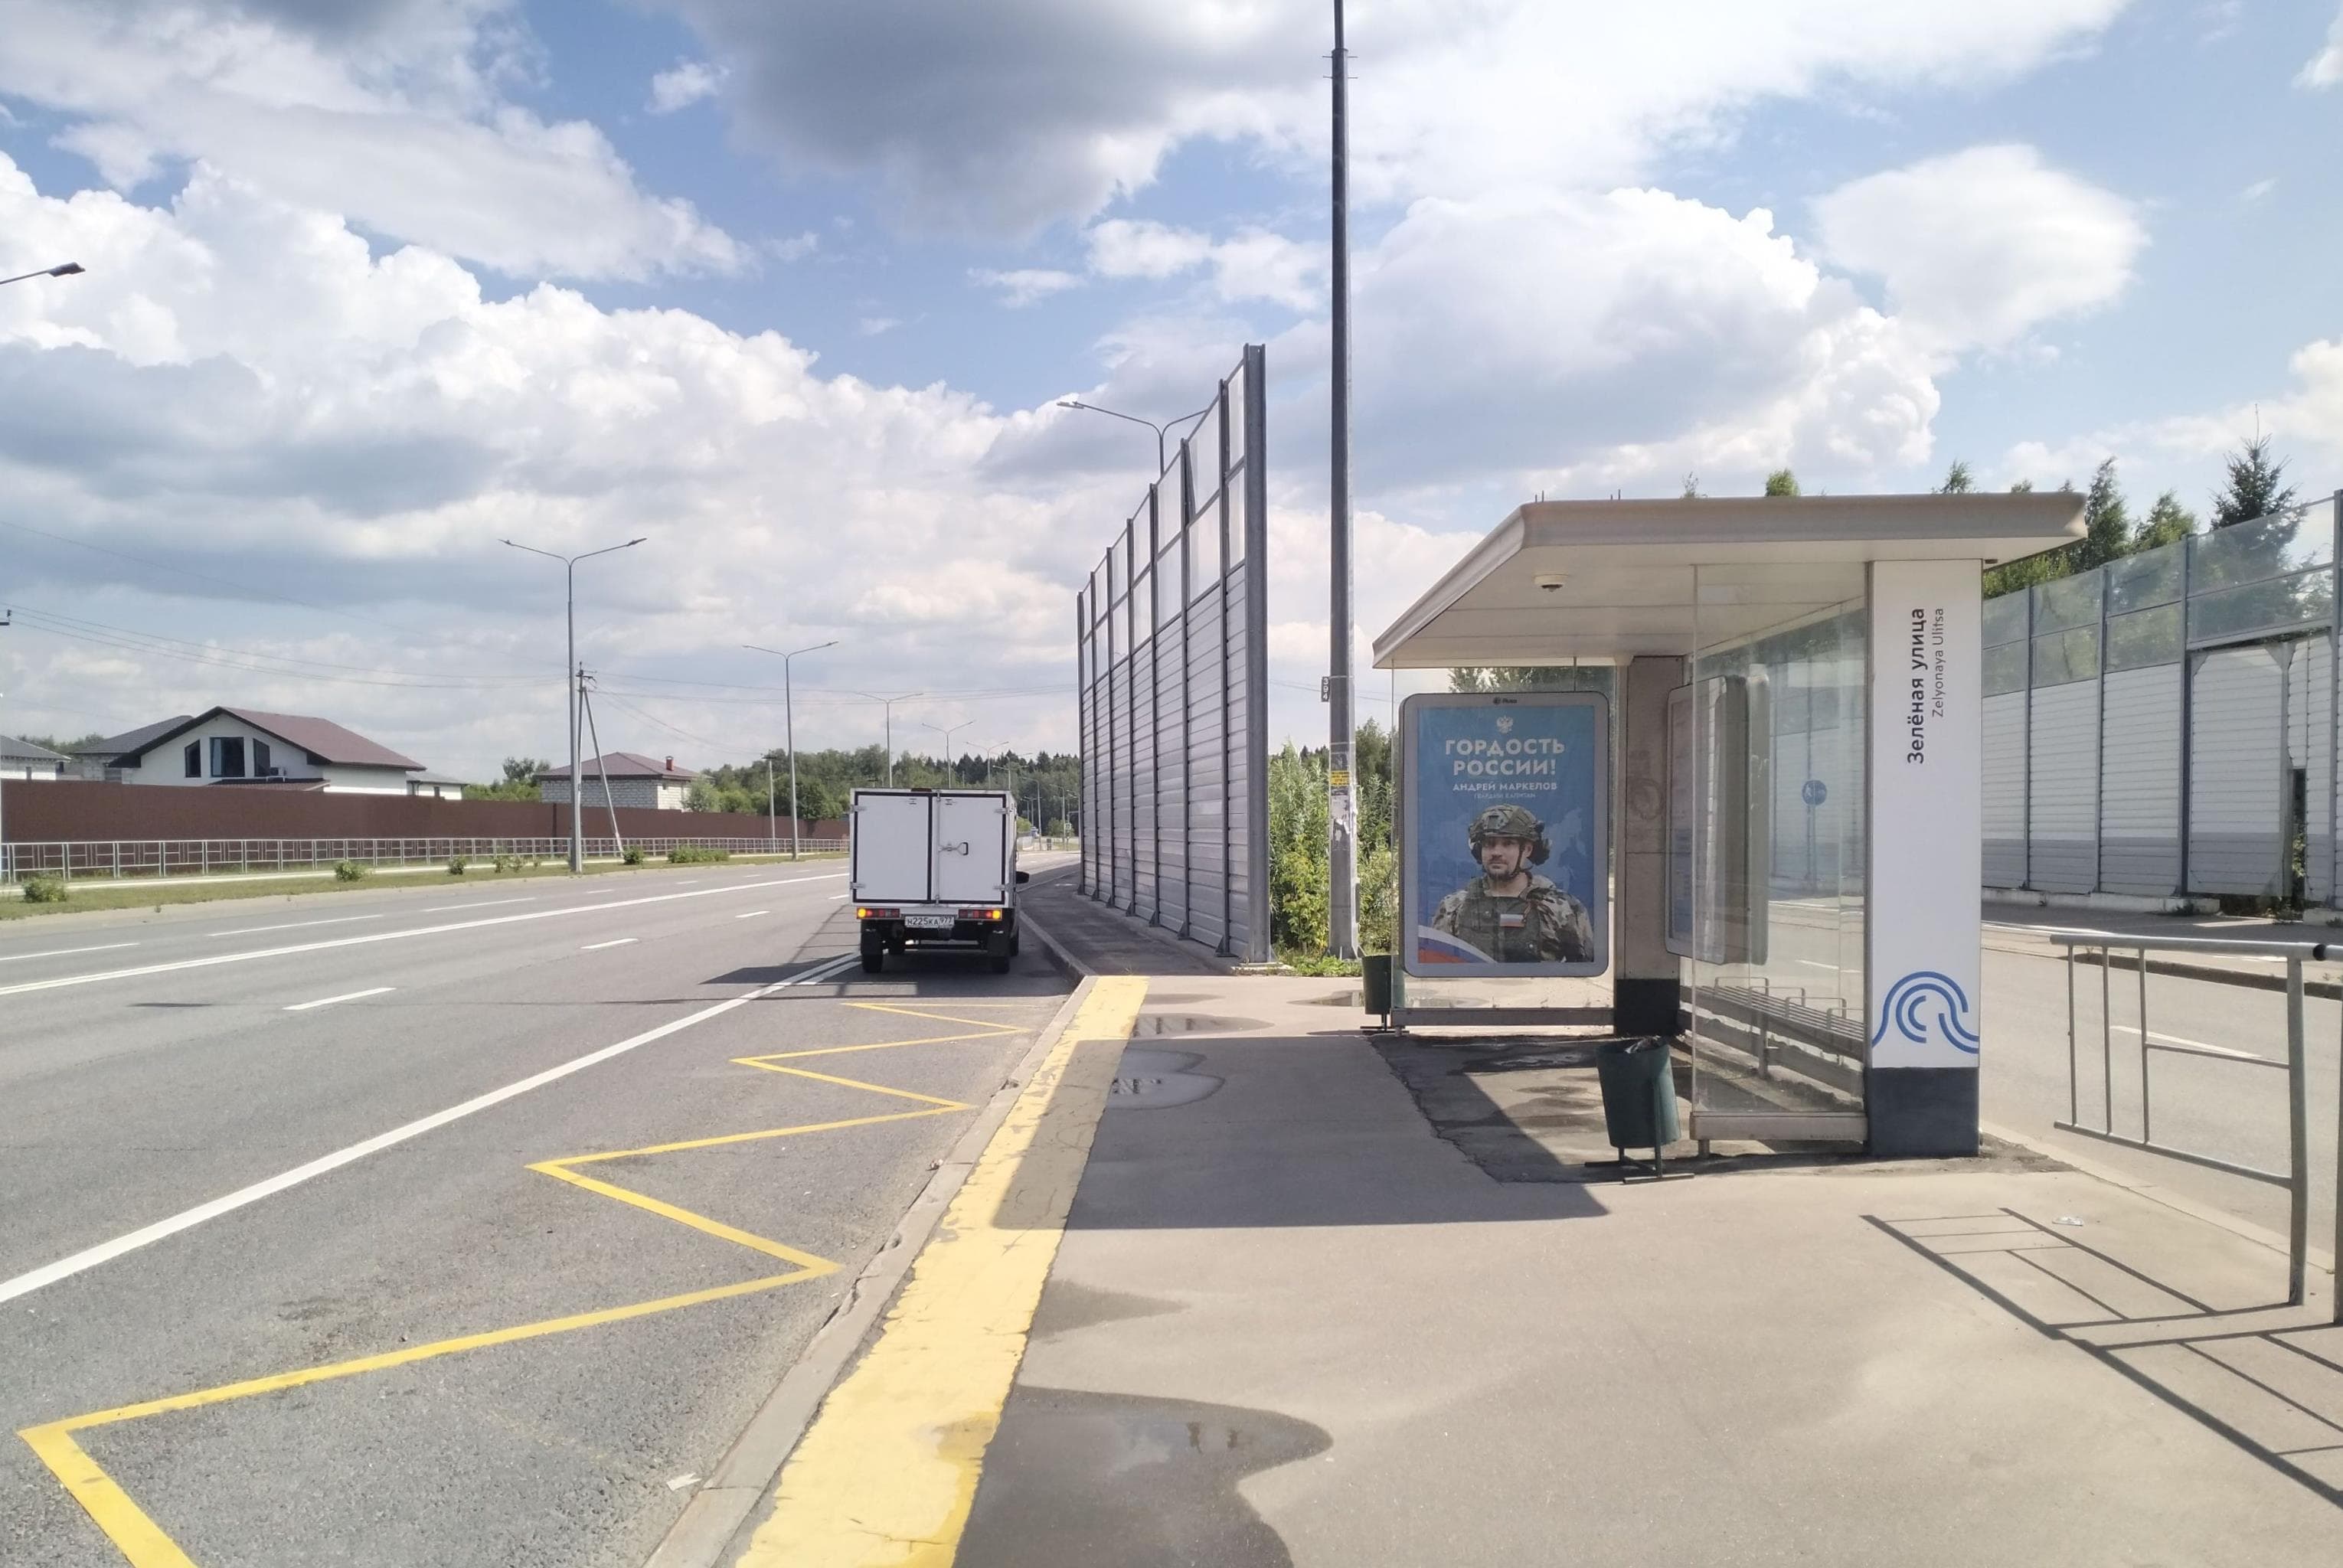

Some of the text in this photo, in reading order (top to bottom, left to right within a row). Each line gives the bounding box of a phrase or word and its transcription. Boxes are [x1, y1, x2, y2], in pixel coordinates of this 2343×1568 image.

[1932, 608, 1946, 718] Zelyonaya Ulitsa
[1907, 609, 1928, 764] Зелёная улица
[1445, 738, 1566, 757] ГОРДОСТЬ
[1453, 759, 1557, 776] РОССИИ!
[1453, 780, 1558, 792] АНДРЕЙ МАРКЕЛОВ
